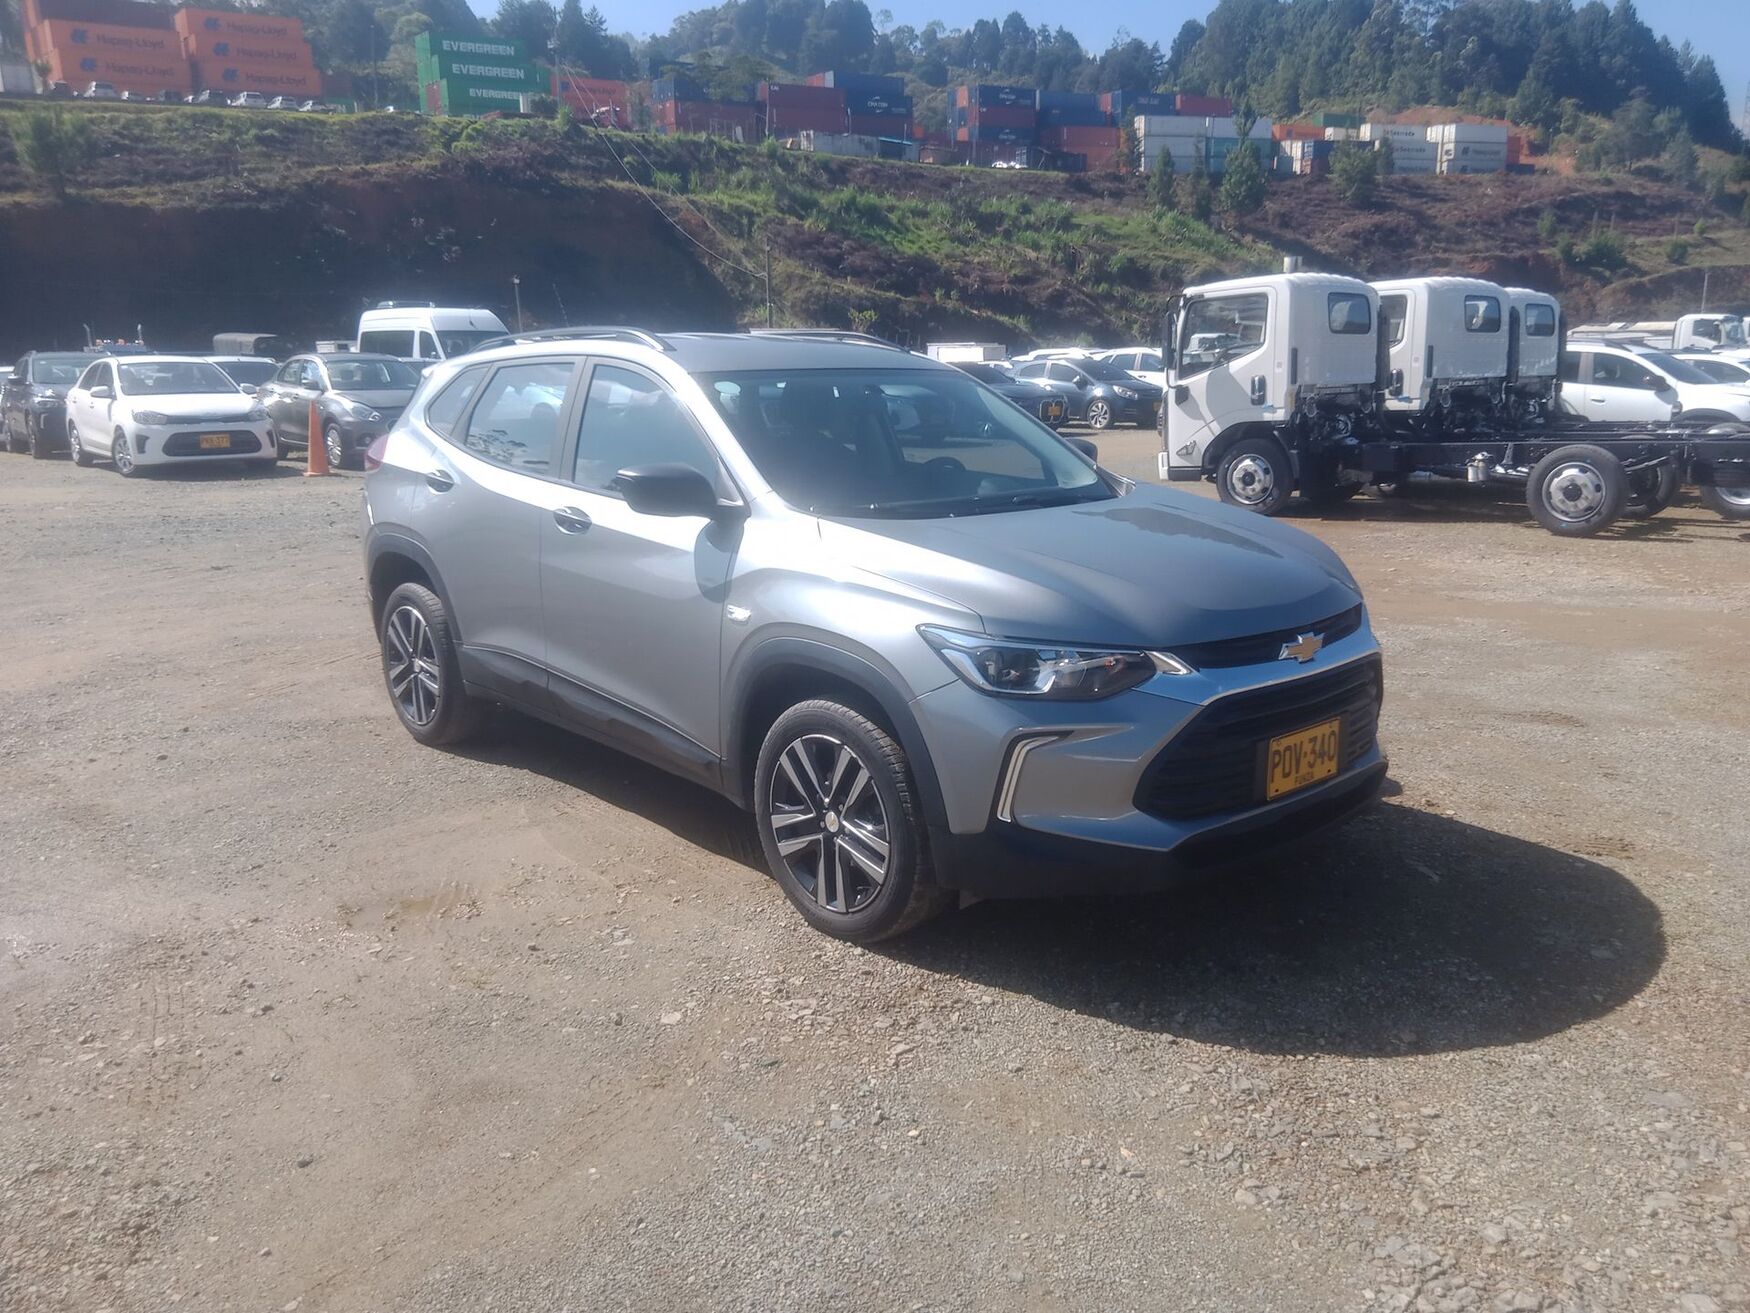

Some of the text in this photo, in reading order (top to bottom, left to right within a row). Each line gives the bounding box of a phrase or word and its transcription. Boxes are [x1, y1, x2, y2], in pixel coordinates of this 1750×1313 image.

[442, 40, 515, 56] EVERGREEN
[452, 63, 525, 79] EVERGREEN
[469, 88, 520, 100] EVERGREE
